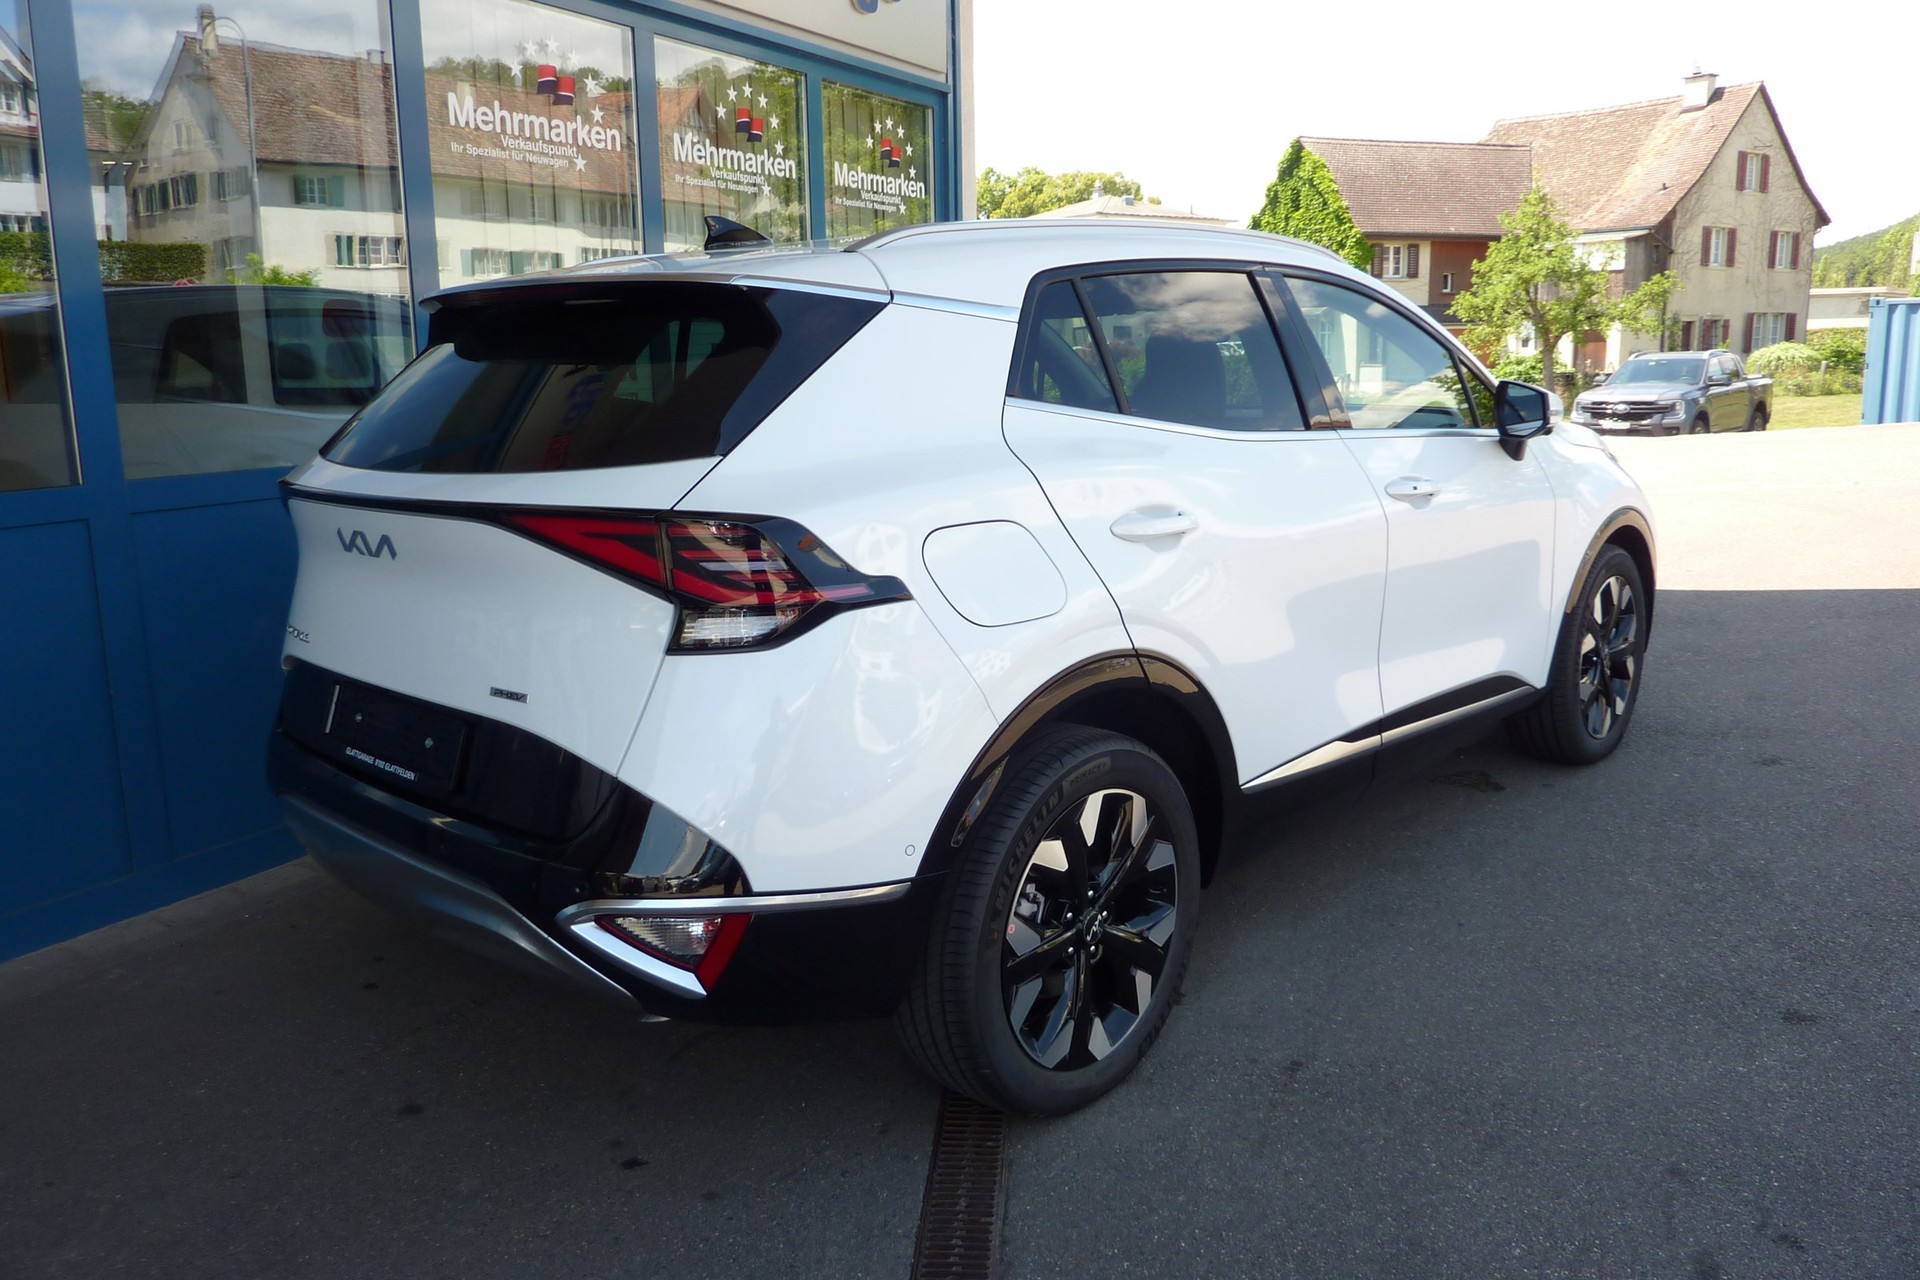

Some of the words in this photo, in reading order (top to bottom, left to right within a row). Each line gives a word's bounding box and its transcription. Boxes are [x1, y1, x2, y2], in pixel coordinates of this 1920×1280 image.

[447, 91, 621, 152] Mehrmarken
[451, 141, 464, 153] Ihr
[466, 143, 509, 160] Spezialist
[511, 151, 524, 162] für
[526, 152, 569, 169] Neuwagen
[500, 134, 577, 158] Verkaufspunkt
[673, 131, 796, 179] Mehrmarken
[675, 174, 685, 183] Ihr
[685, 175, 717, 188] Spezialist
[717, 180, 727, 190] für
[728, 181, 759, 195] Neuwagen
[710, 166, 765, 185] Verkaufspunkt
[834, 160, 925, 200] Mehrmarken
[860, 189, 902, 205] Verkaufspunkt
[337, 527, 397, 560] KIA
